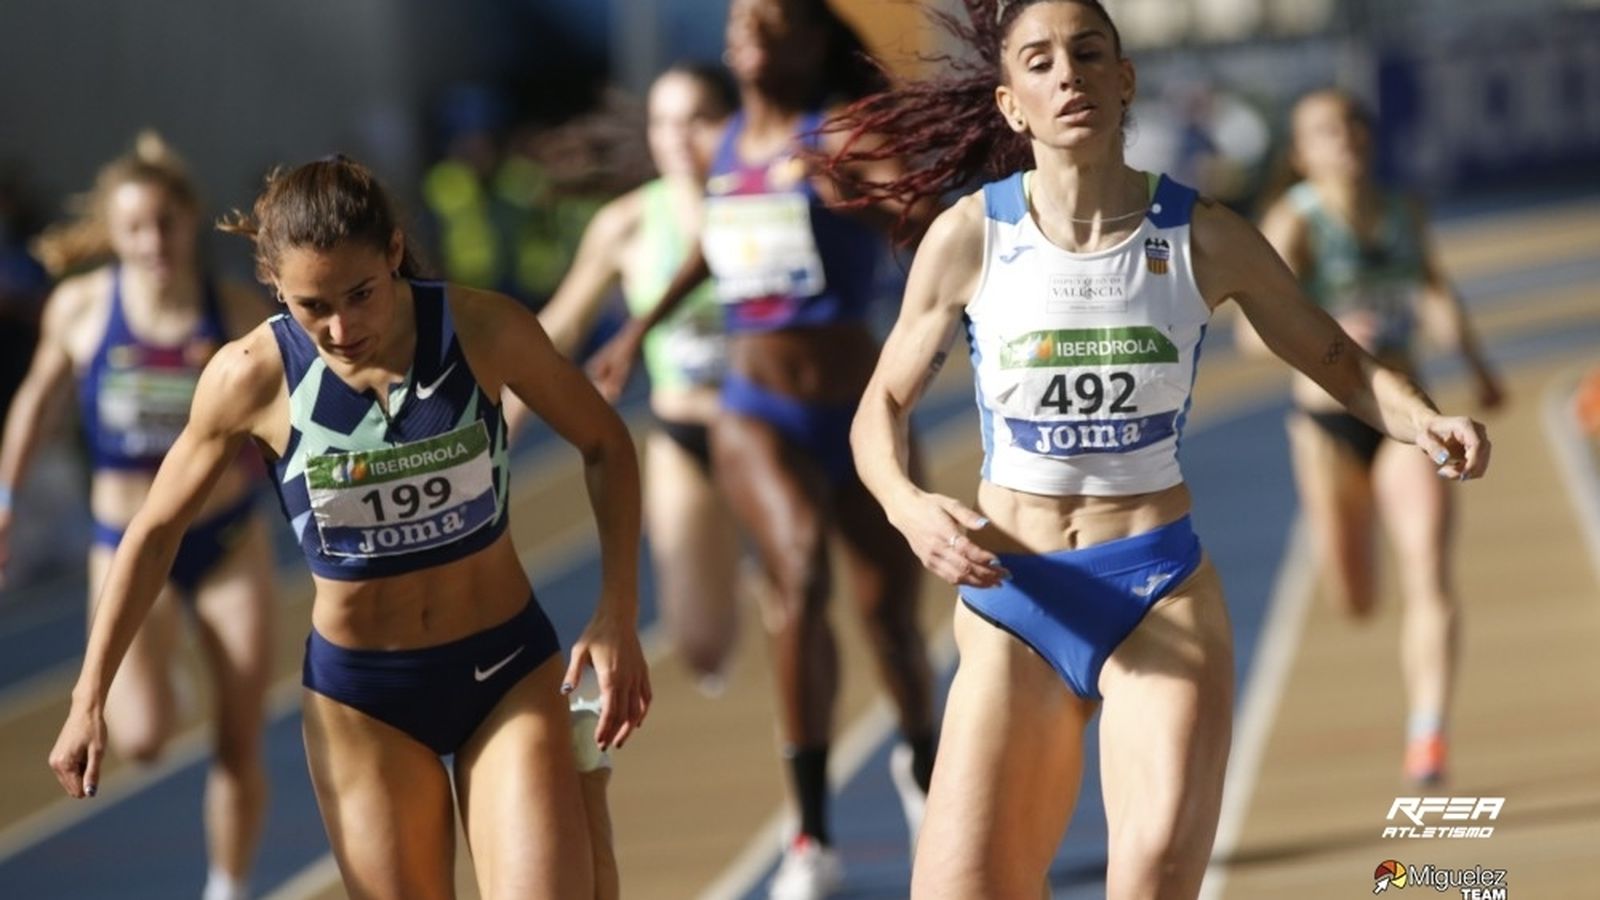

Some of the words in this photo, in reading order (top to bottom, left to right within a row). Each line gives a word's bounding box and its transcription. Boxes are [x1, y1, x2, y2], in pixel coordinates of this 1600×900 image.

[1057, 339, 1159, 357] IBERDROLA
[1040, 371, 1138, 415] 492
[369, 442, 468, 477] IBERDROLA
[361, 476, 452, 523] 199
